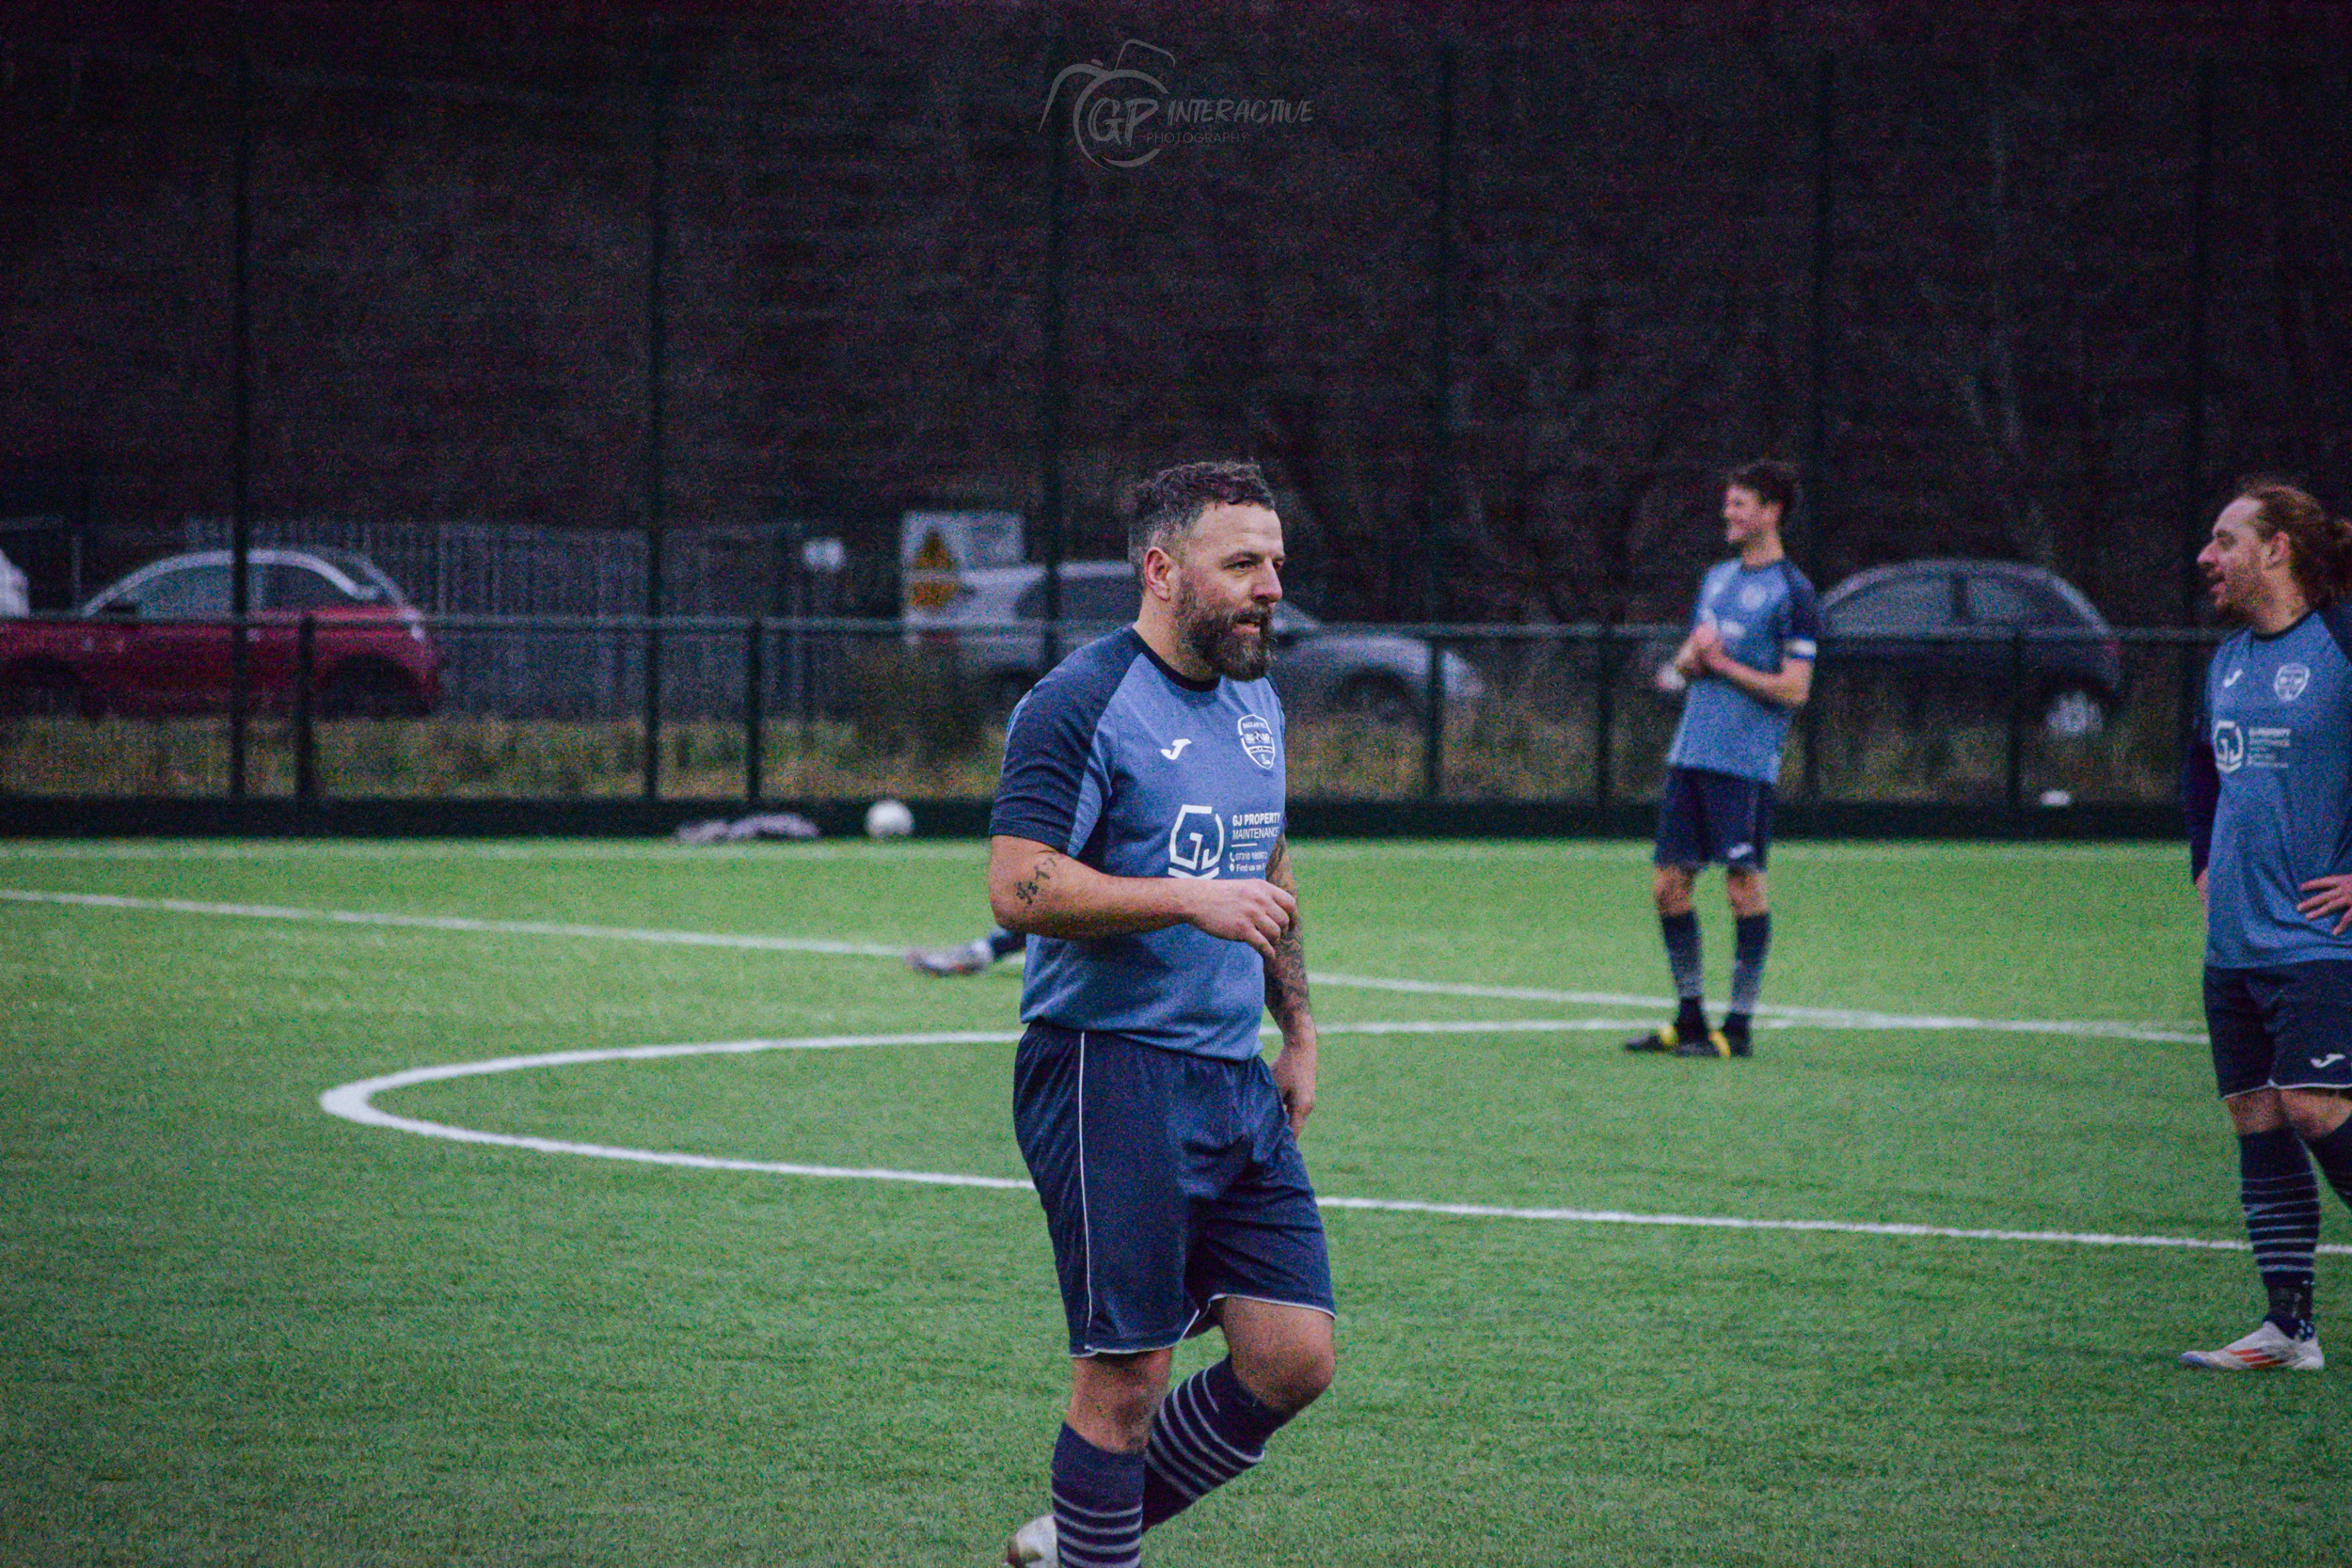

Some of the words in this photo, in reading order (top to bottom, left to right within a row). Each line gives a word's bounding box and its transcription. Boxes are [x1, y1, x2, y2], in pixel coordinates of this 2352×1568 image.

[1232, 815, 1242, 827] GJ
[1244, 812, 1280, 826] PROPERTY
[1232, 827, 1279, 840] MAINTENANCE
